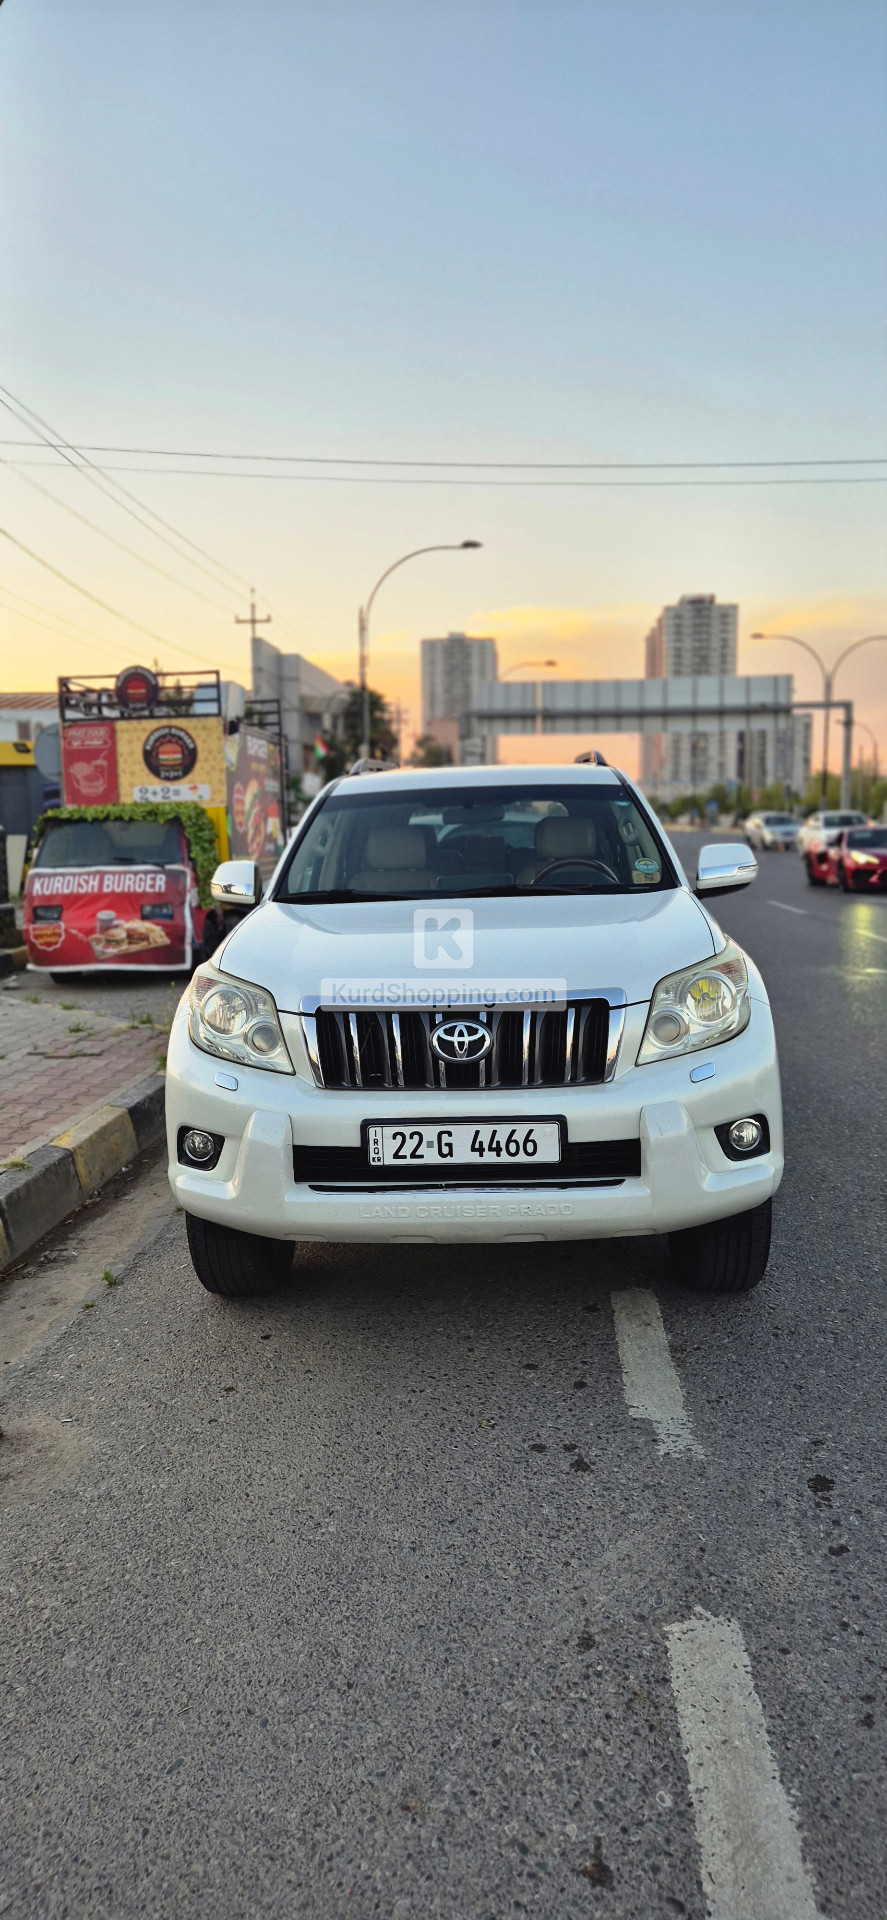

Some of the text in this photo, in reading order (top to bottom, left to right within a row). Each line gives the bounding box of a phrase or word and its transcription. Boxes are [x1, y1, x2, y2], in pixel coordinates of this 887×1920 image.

[145, 727, 195, 750] KURDISH BURGER
[32, 873, 166, 896] KURDISH BURGER
[470, 1128, 538, 1158] 4466
[360, 1203, 574, 1219] LAND CRUISER PRADO
